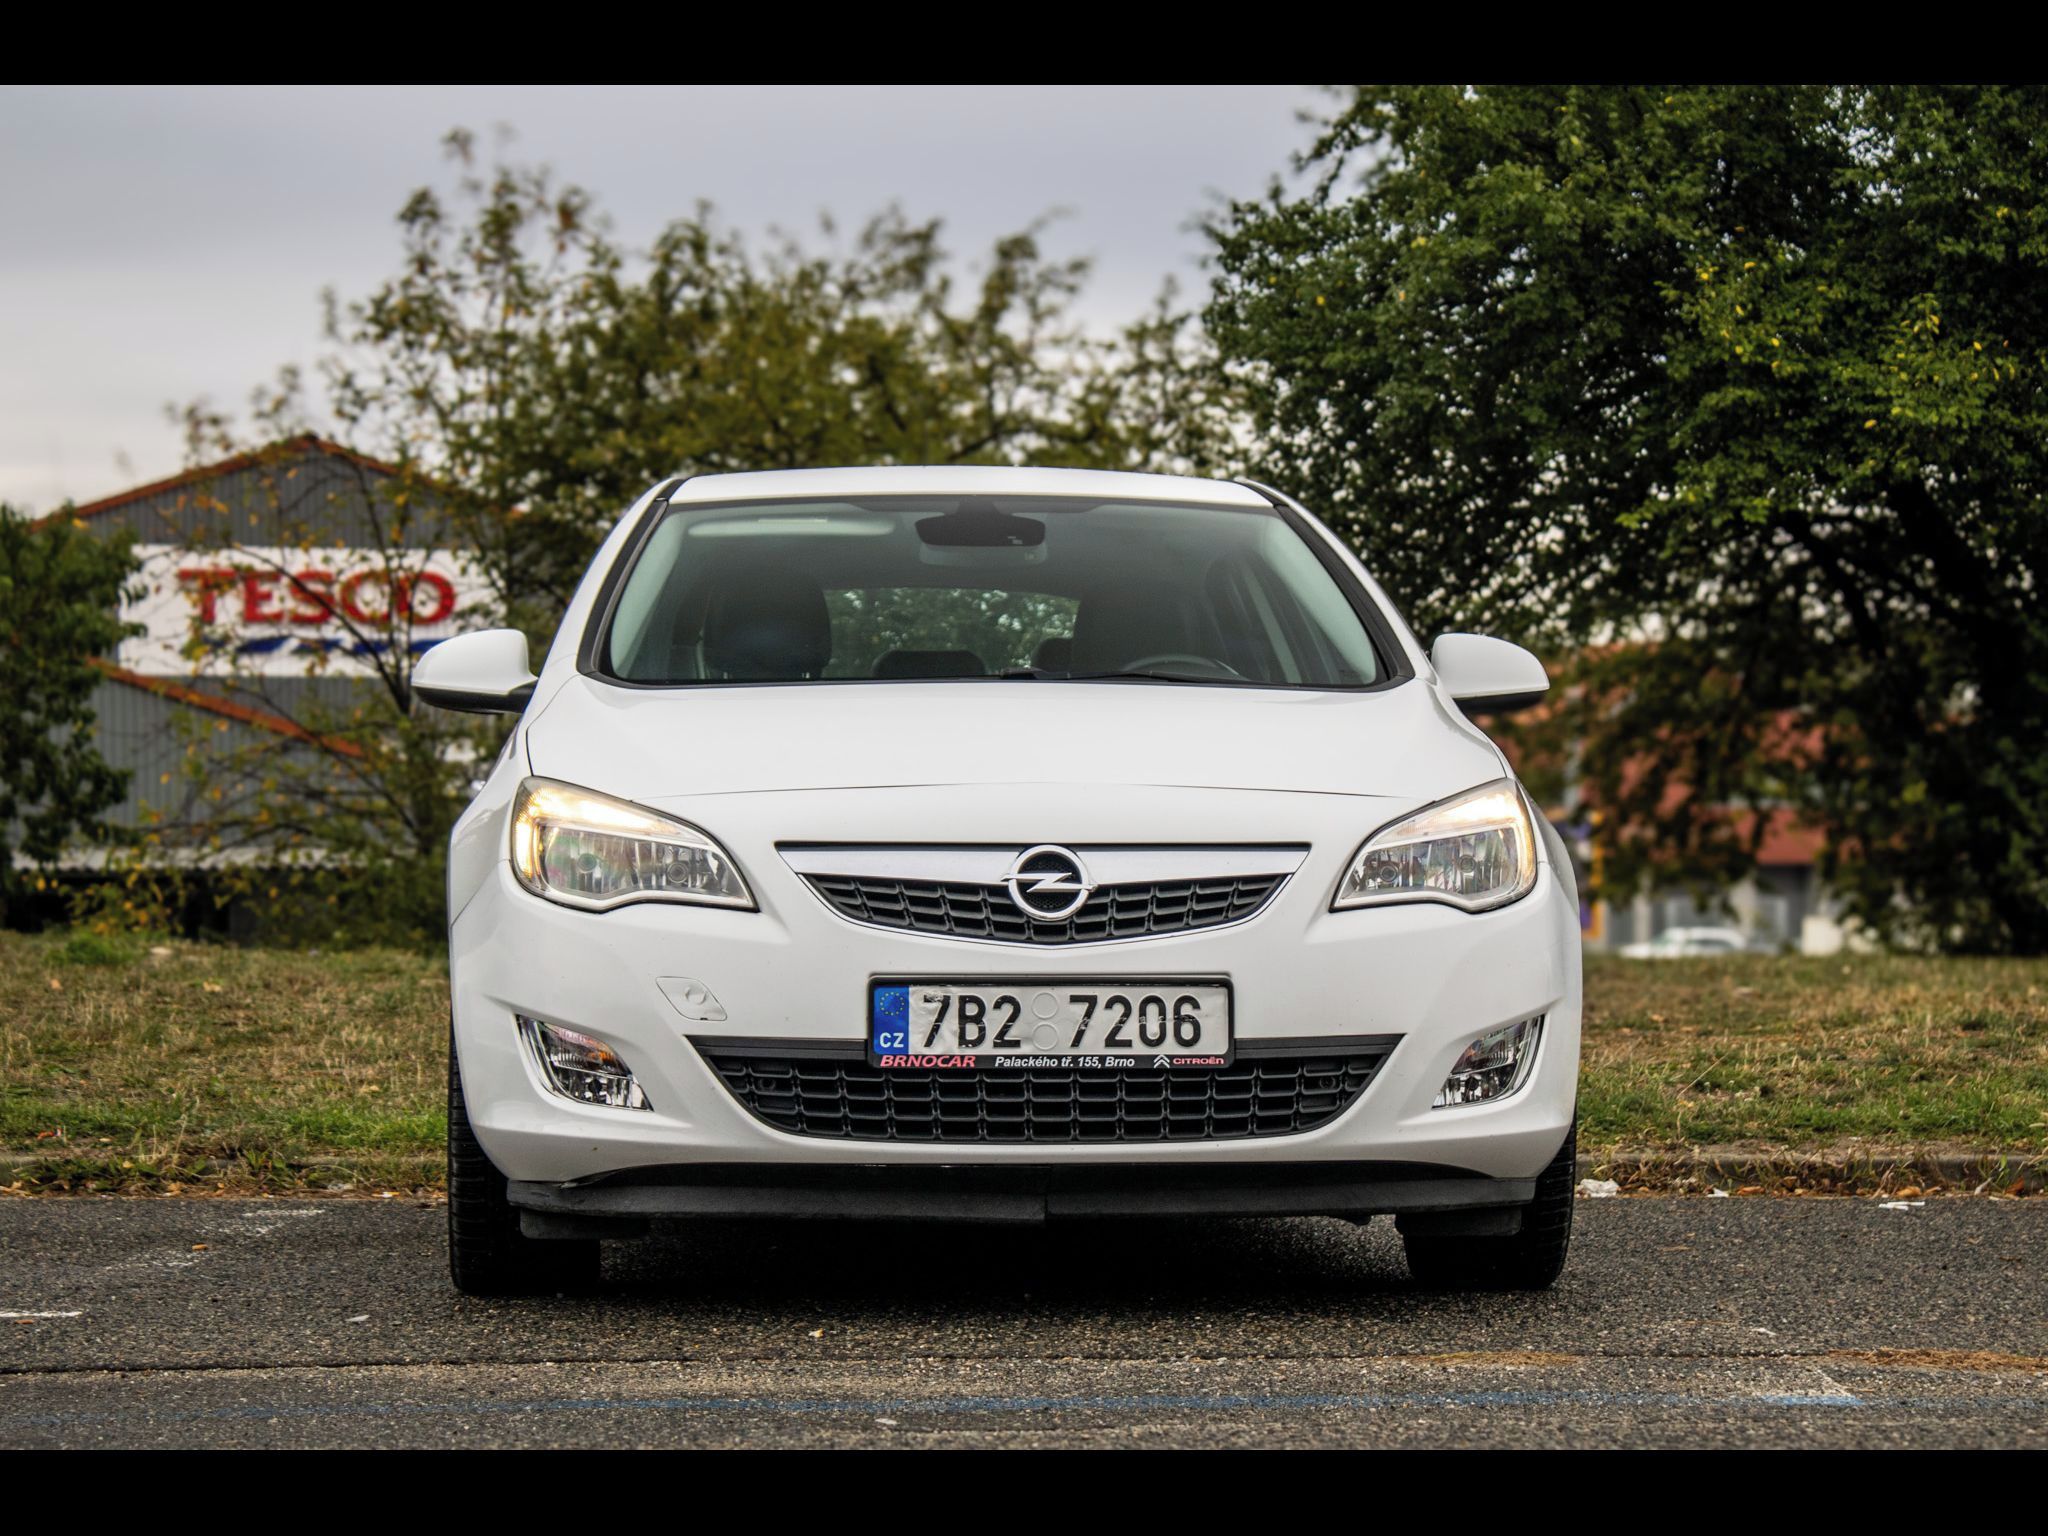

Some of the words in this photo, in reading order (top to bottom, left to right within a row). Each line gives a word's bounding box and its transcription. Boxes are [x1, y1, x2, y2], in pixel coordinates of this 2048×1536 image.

[178, 569, 455, 624] TESCO
[923, 995, 1022, 1048] 7B2
[1069, 995, 1201, 1048] 7206
[879, 1032, 904, 1049] CZ
[880, 1055, 975, 1068] BRNOCAR
[995, 1057, 1058, 1067] Palackého
[1077, 1057, 1101, 1069] 155,
[1105, 1057, 1135, 1067] Brno
